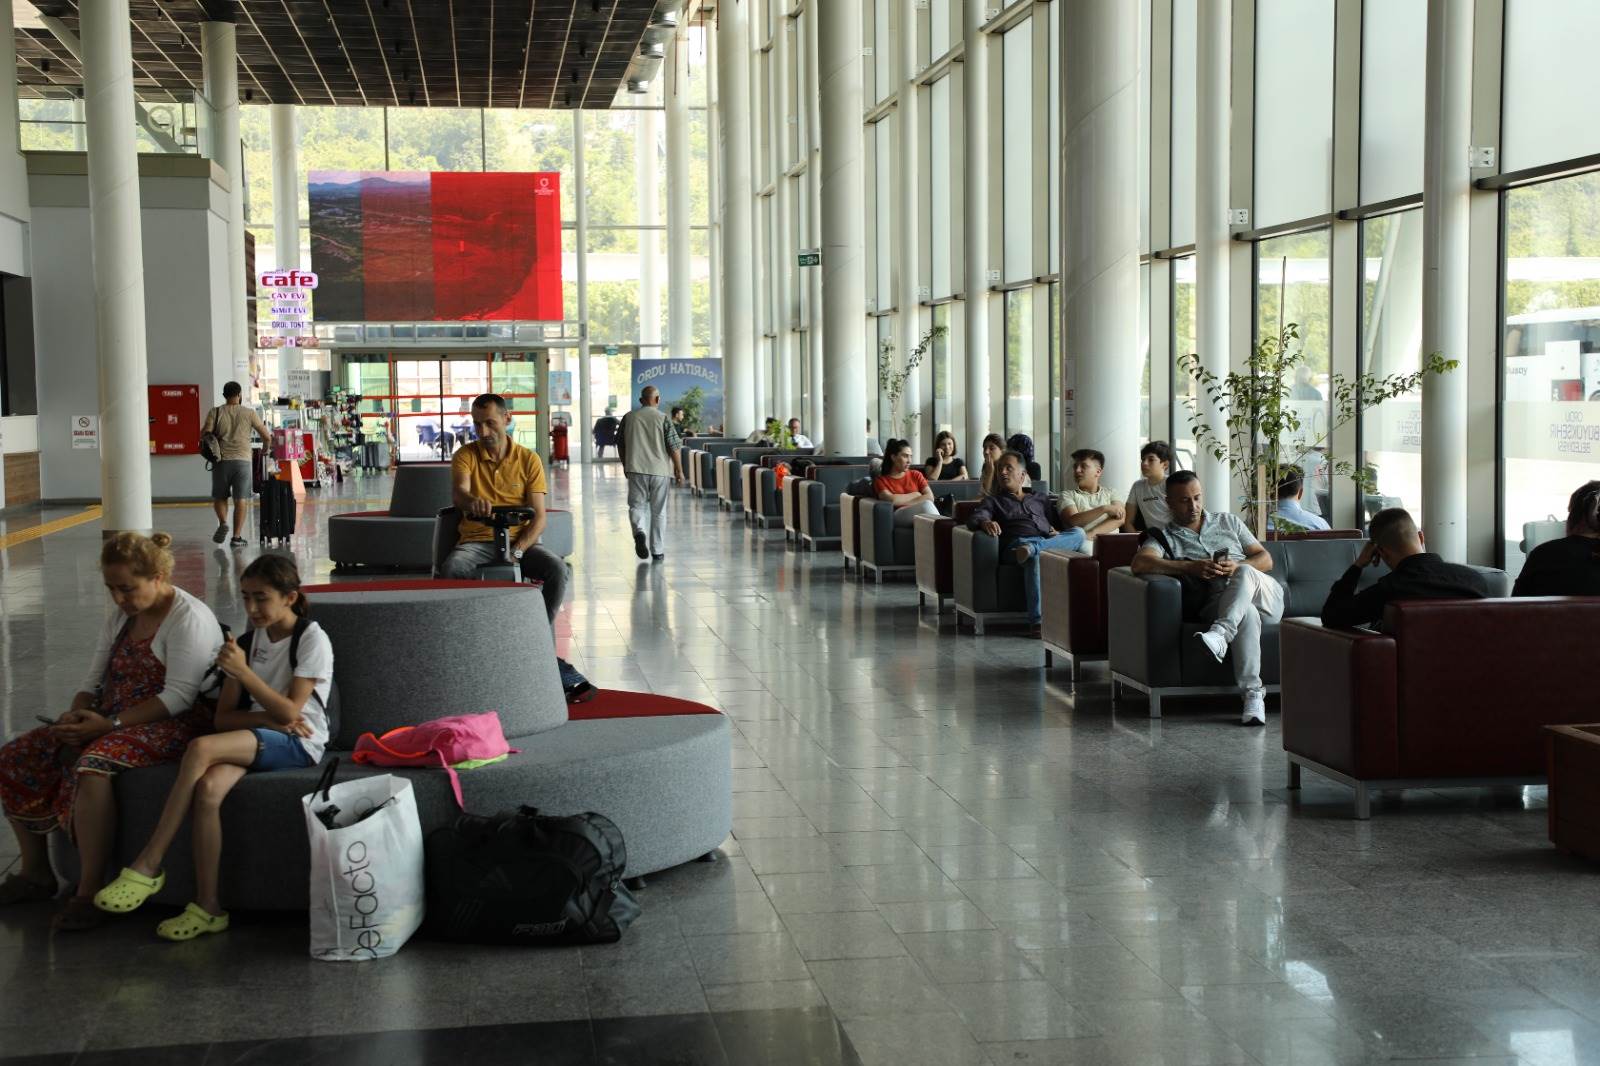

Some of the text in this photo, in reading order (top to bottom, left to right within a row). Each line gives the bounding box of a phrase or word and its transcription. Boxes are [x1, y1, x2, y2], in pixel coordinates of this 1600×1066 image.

[261, 270, 314, 287] cafe
[637, 362, 719, 384] ORDU HATIRASI
